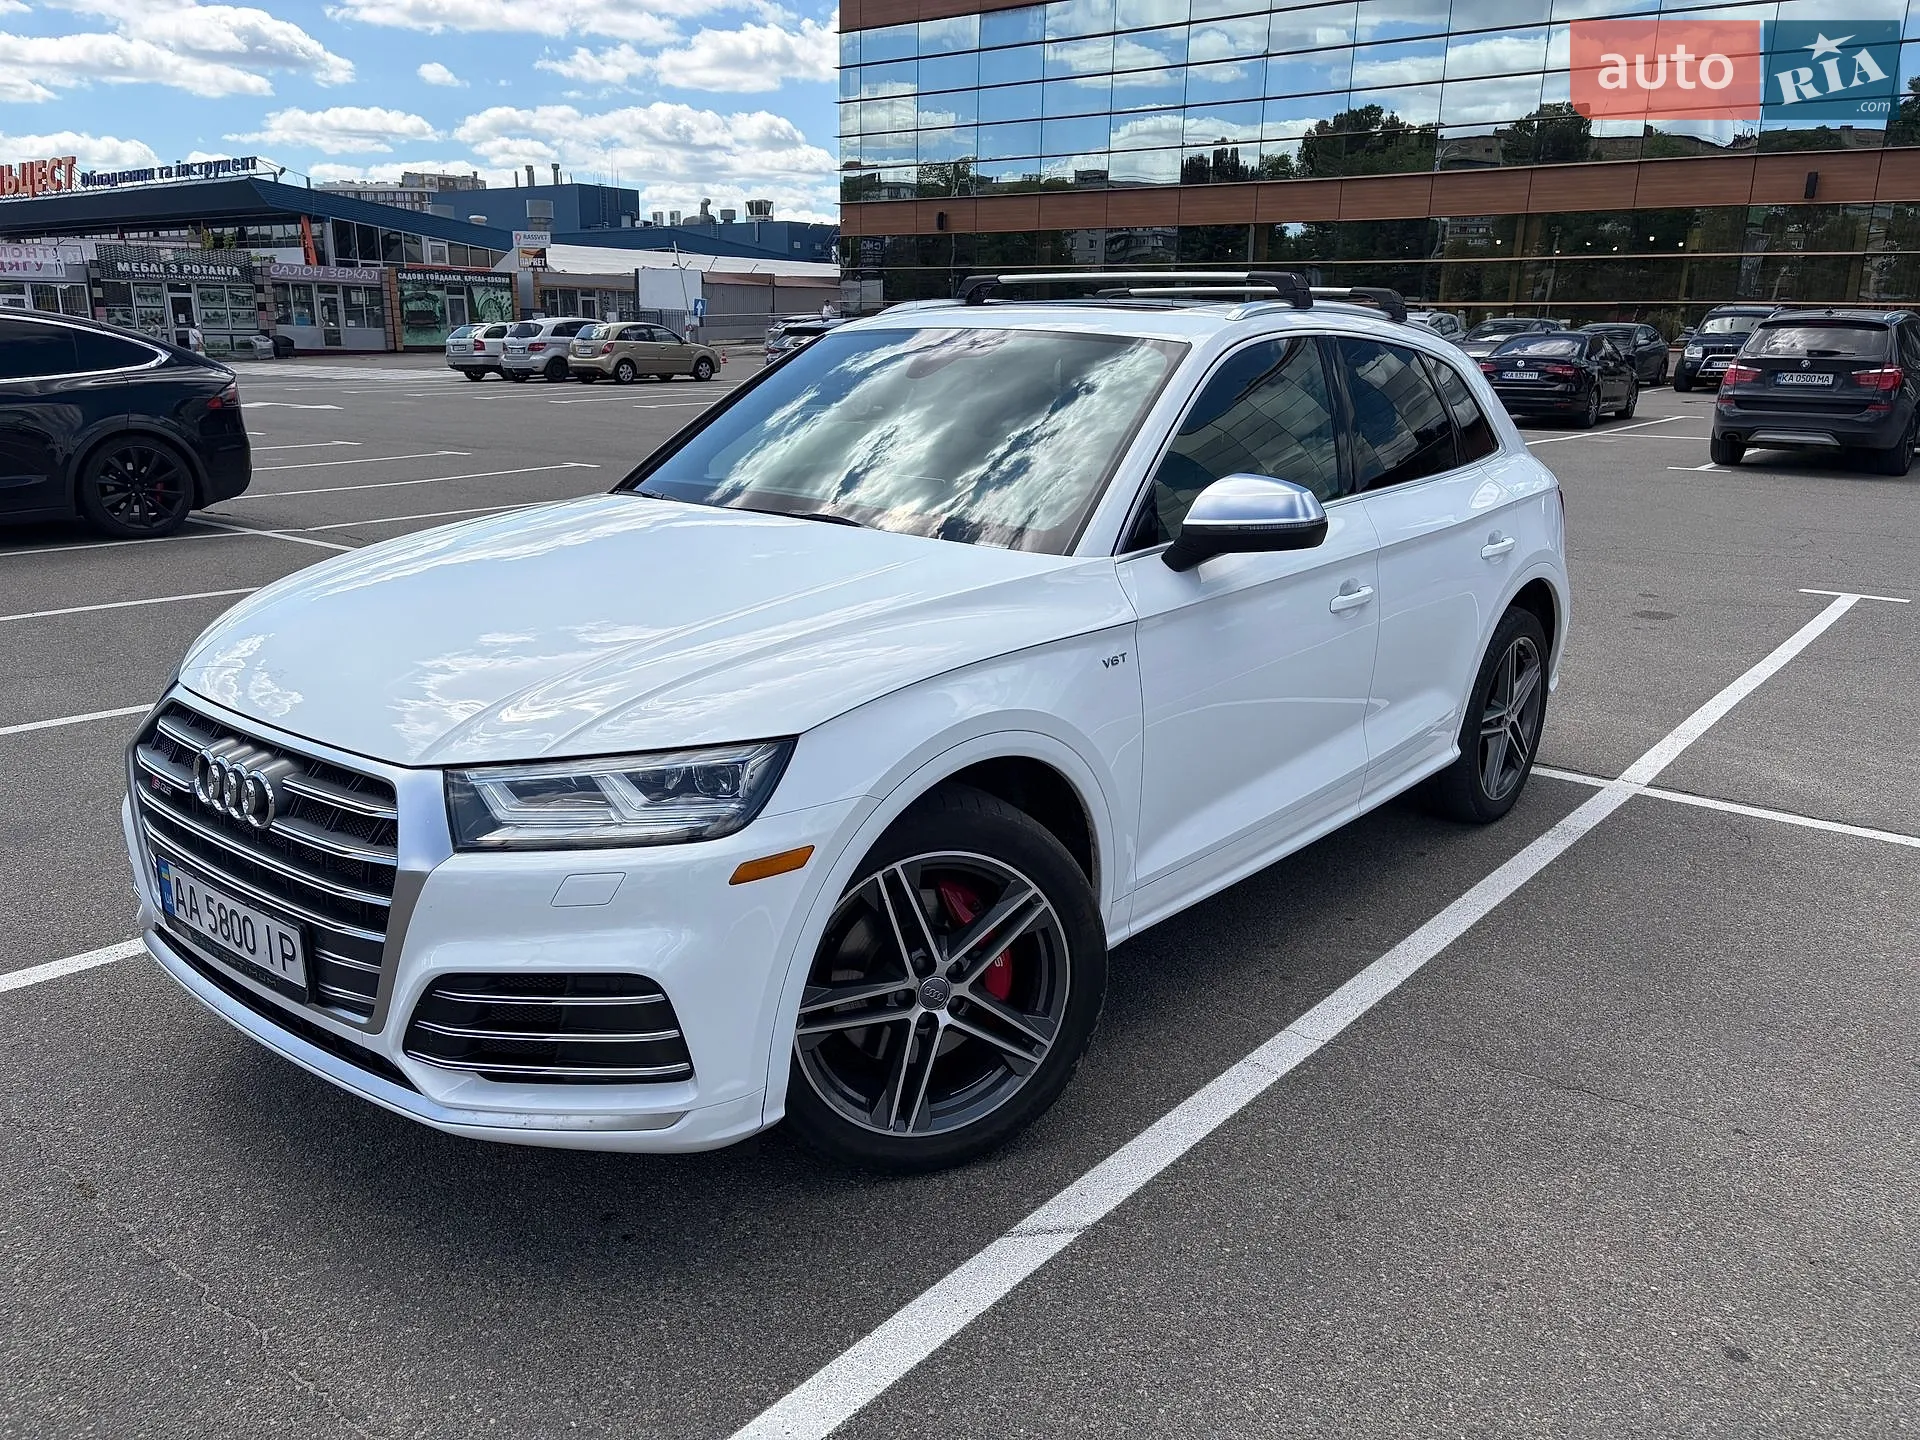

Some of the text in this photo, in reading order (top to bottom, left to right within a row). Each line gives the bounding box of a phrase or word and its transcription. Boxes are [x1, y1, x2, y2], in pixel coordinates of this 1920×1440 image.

[0, 156, 77, 198] ЬЦЕСТ
[117, 261, 165, 274] МЕБЛІ
[183, 264, 241, 277] РОТАНГА
[270, 264, 379, 281] САЛОН ЗЕРКАЛ
[1781, 374, 1830, 384] KA 0500 MA
[175, 876, 204, 928] AA
[204, 893, 257, 955] 5800
[265, 924, 297, 972] IP
